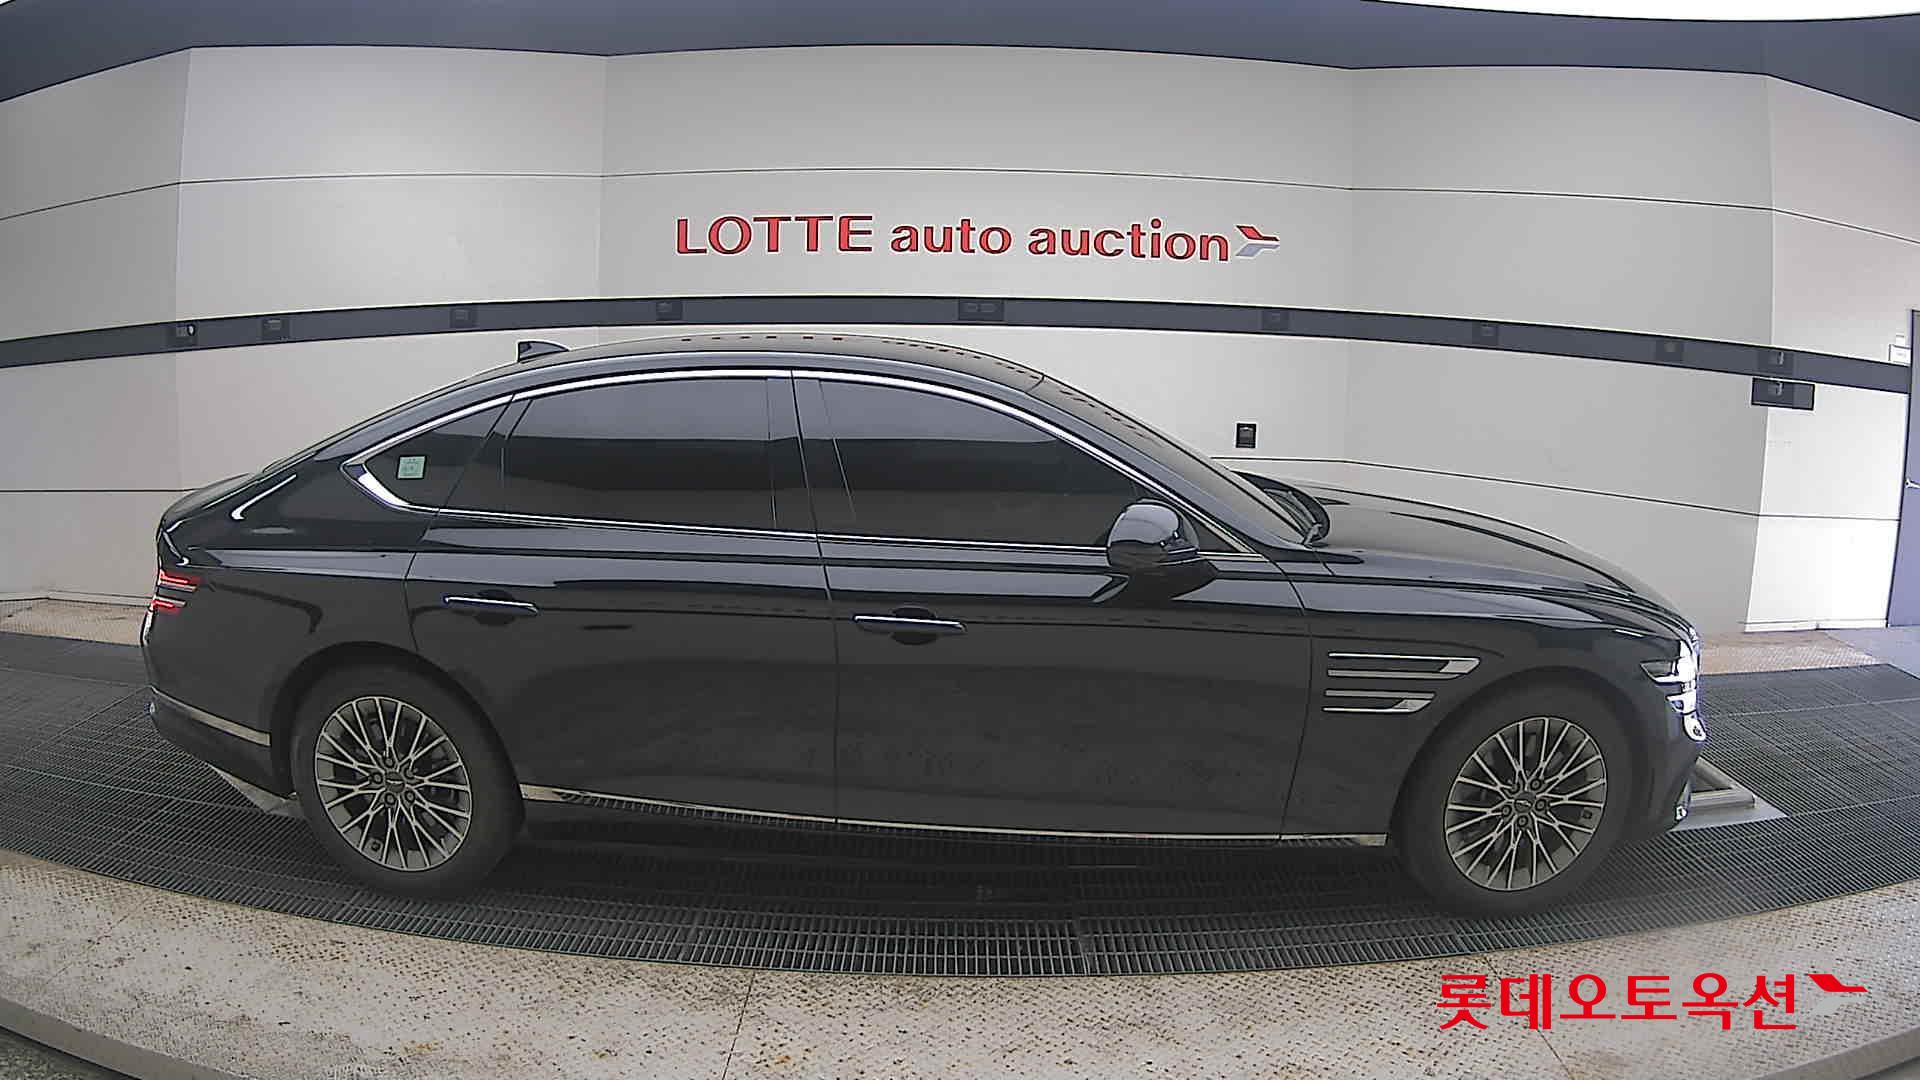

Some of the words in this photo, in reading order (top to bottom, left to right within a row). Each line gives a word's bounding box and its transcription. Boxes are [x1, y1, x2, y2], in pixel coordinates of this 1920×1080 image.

[676, 216, 873, 254] LOTTE
[891, 219, 1011, 254] auto
[1028, 220, 1229, 260] auction
